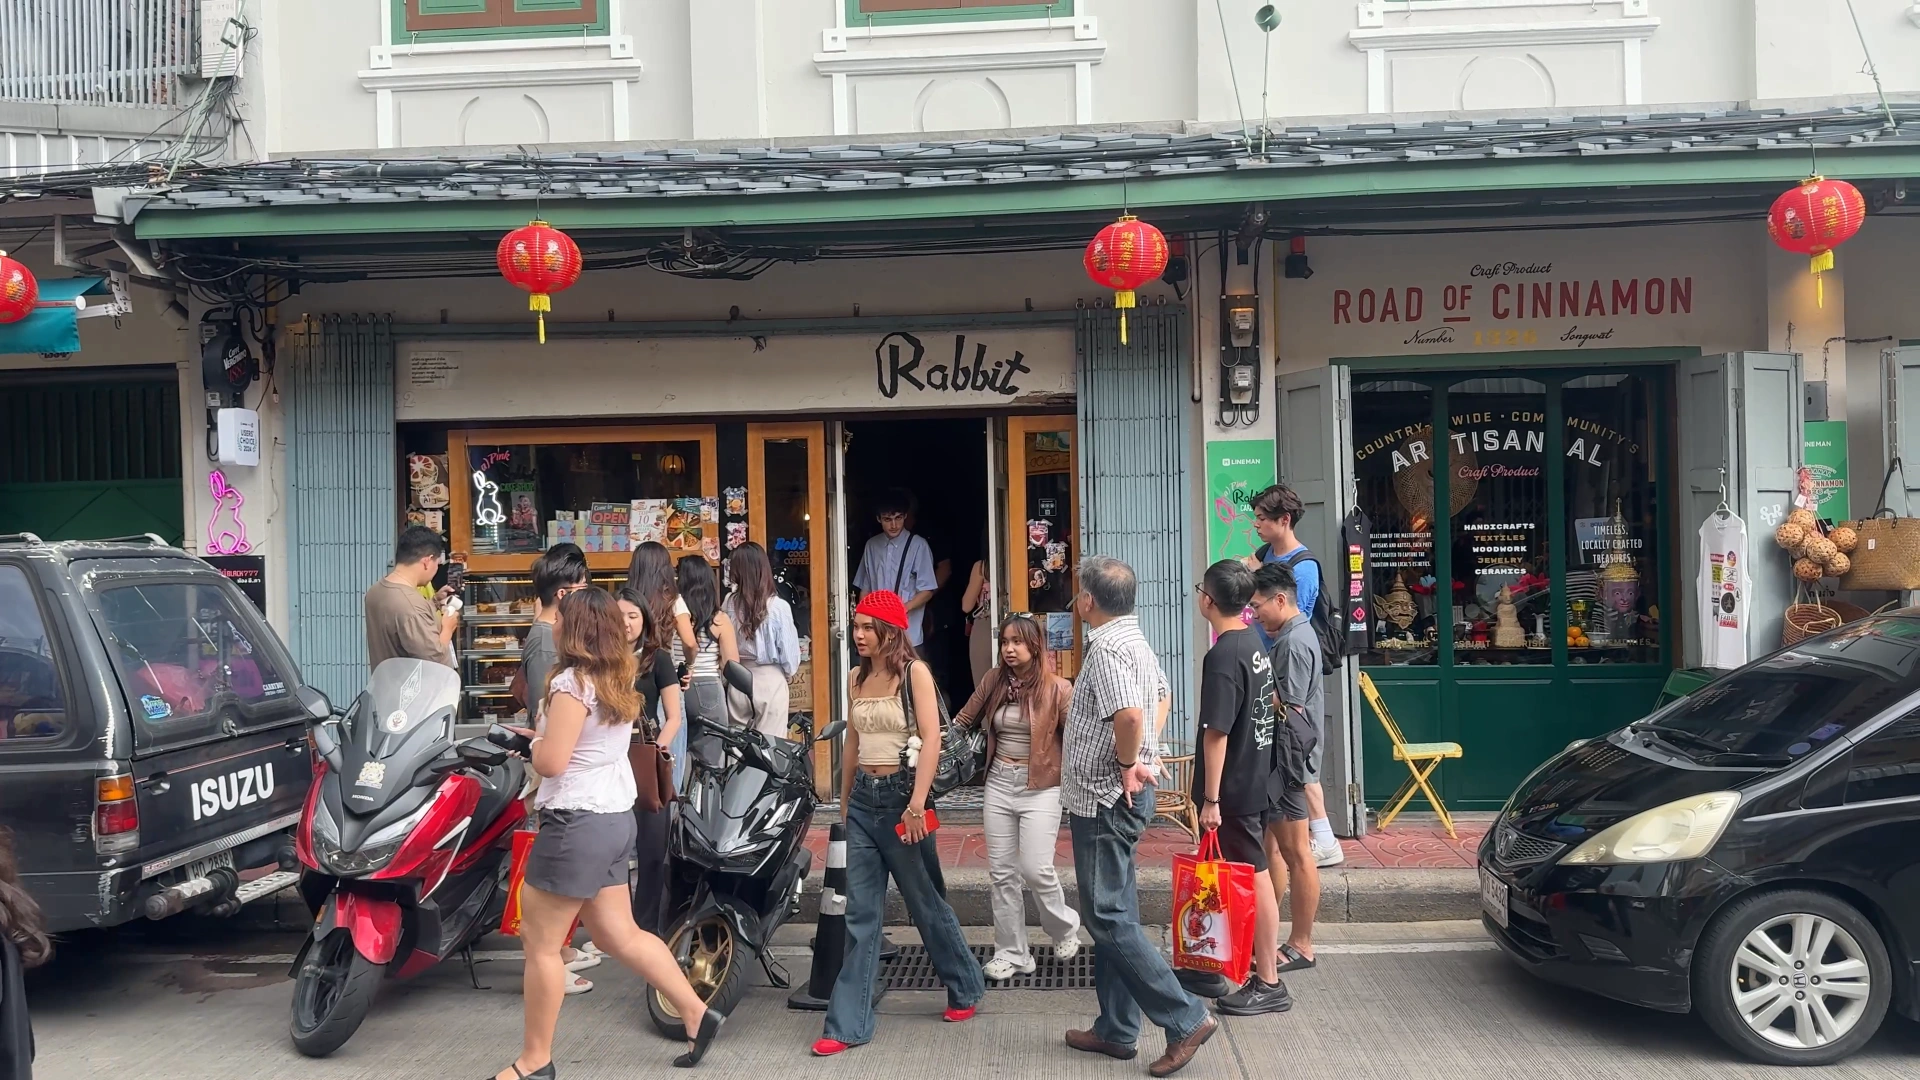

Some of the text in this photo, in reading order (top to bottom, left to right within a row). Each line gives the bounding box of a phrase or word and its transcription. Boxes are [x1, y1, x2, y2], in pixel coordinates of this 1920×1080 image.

[1470, 261, 1552, 279] Craft Product
[1333, 277, 1692, 324] ROAD OF CINNAMON
[1404, 326, 1455, 345] Number
[1560, 325, 1614, 347] Songwat
[875, 332, 1031, 398] Rabbit
[1451, 412, 1492, 426] WIDE
[1511, 411, 1544, 423] COM
[1391, 429, 1602, 473] AR TISAN AL
[1458, 463, 1540, 481] Craft Product
[592, 512, 628, 524] OPEN
[638, 515, 650, 525] 10
[1464, 523, 1535, 531] HANDICRAFTS
[775, 537, 807, 550] Bob's
[1474, 534, 1526, 542] TEXTILES
[1581, 538, 1643, 550] LOCALLY CRAFTED
[1472, 545, 1527, 553] WOODWORK
[784, 557, 810, 565] COFFEE
[190, 762, 275, 821] ISUZU
